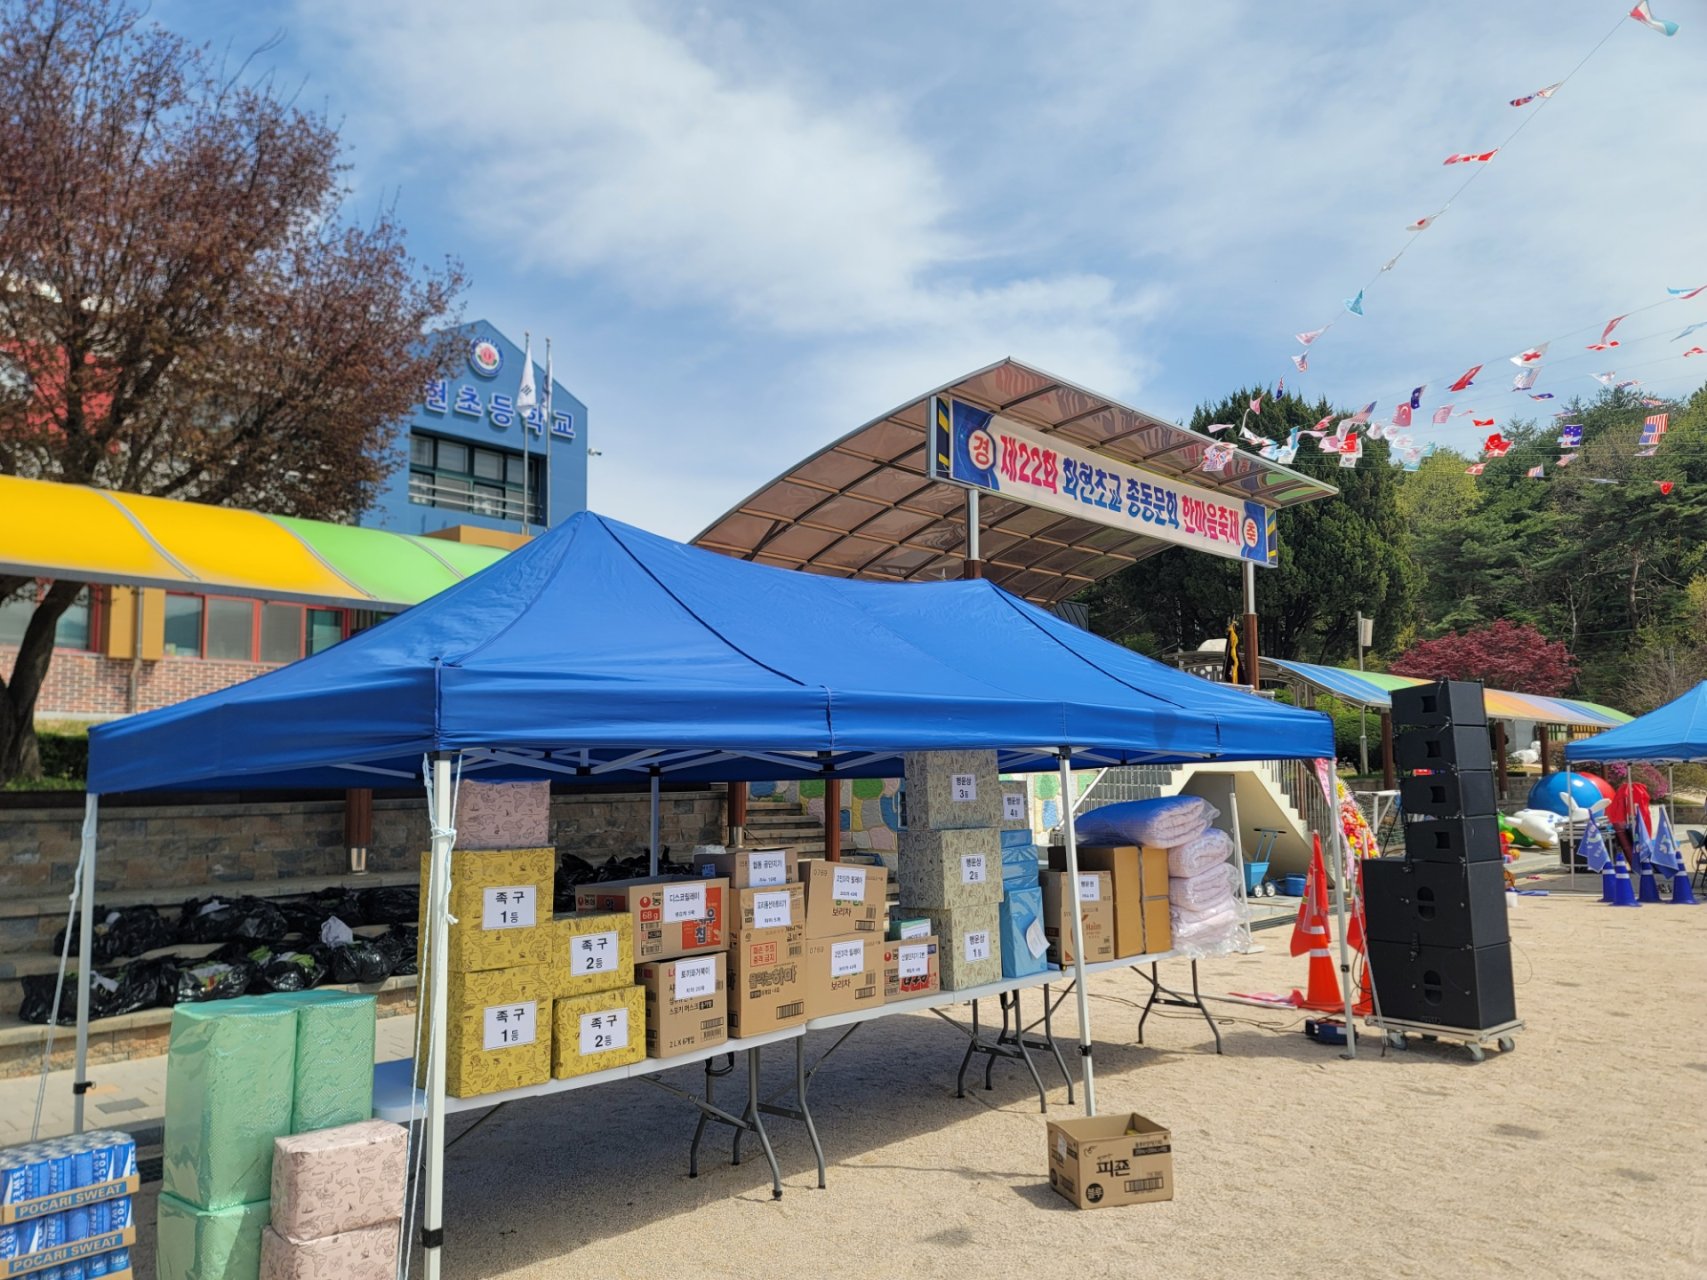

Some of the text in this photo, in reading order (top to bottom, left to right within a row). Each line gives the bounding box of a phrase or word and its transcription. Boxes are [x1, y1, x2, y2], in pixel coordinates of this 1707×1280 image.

[973, 434, 990, 466] 경
[1000, 434, 1241, 546] 제22회 회현초교 총동문회 한마음축제
[956, 776, 972, 786] 행운상
[965, 857, 982, 868] 행운상
[500, 911, 519, 924] 1등
[832, 907, 851, 917] 보리차
[968, 934, 985, 945] 행운상
[586, 957, 603, 970] 2등
[831, 978, 851, 991] 보리차
[500, 1029, 519, 1043] 1등
[594, 1034, 612, 1048] 2등
[19, 1183, 122, 1218] POCARI SWEAT
[13, 1235, 118, 1272] POCARI SWEAT
